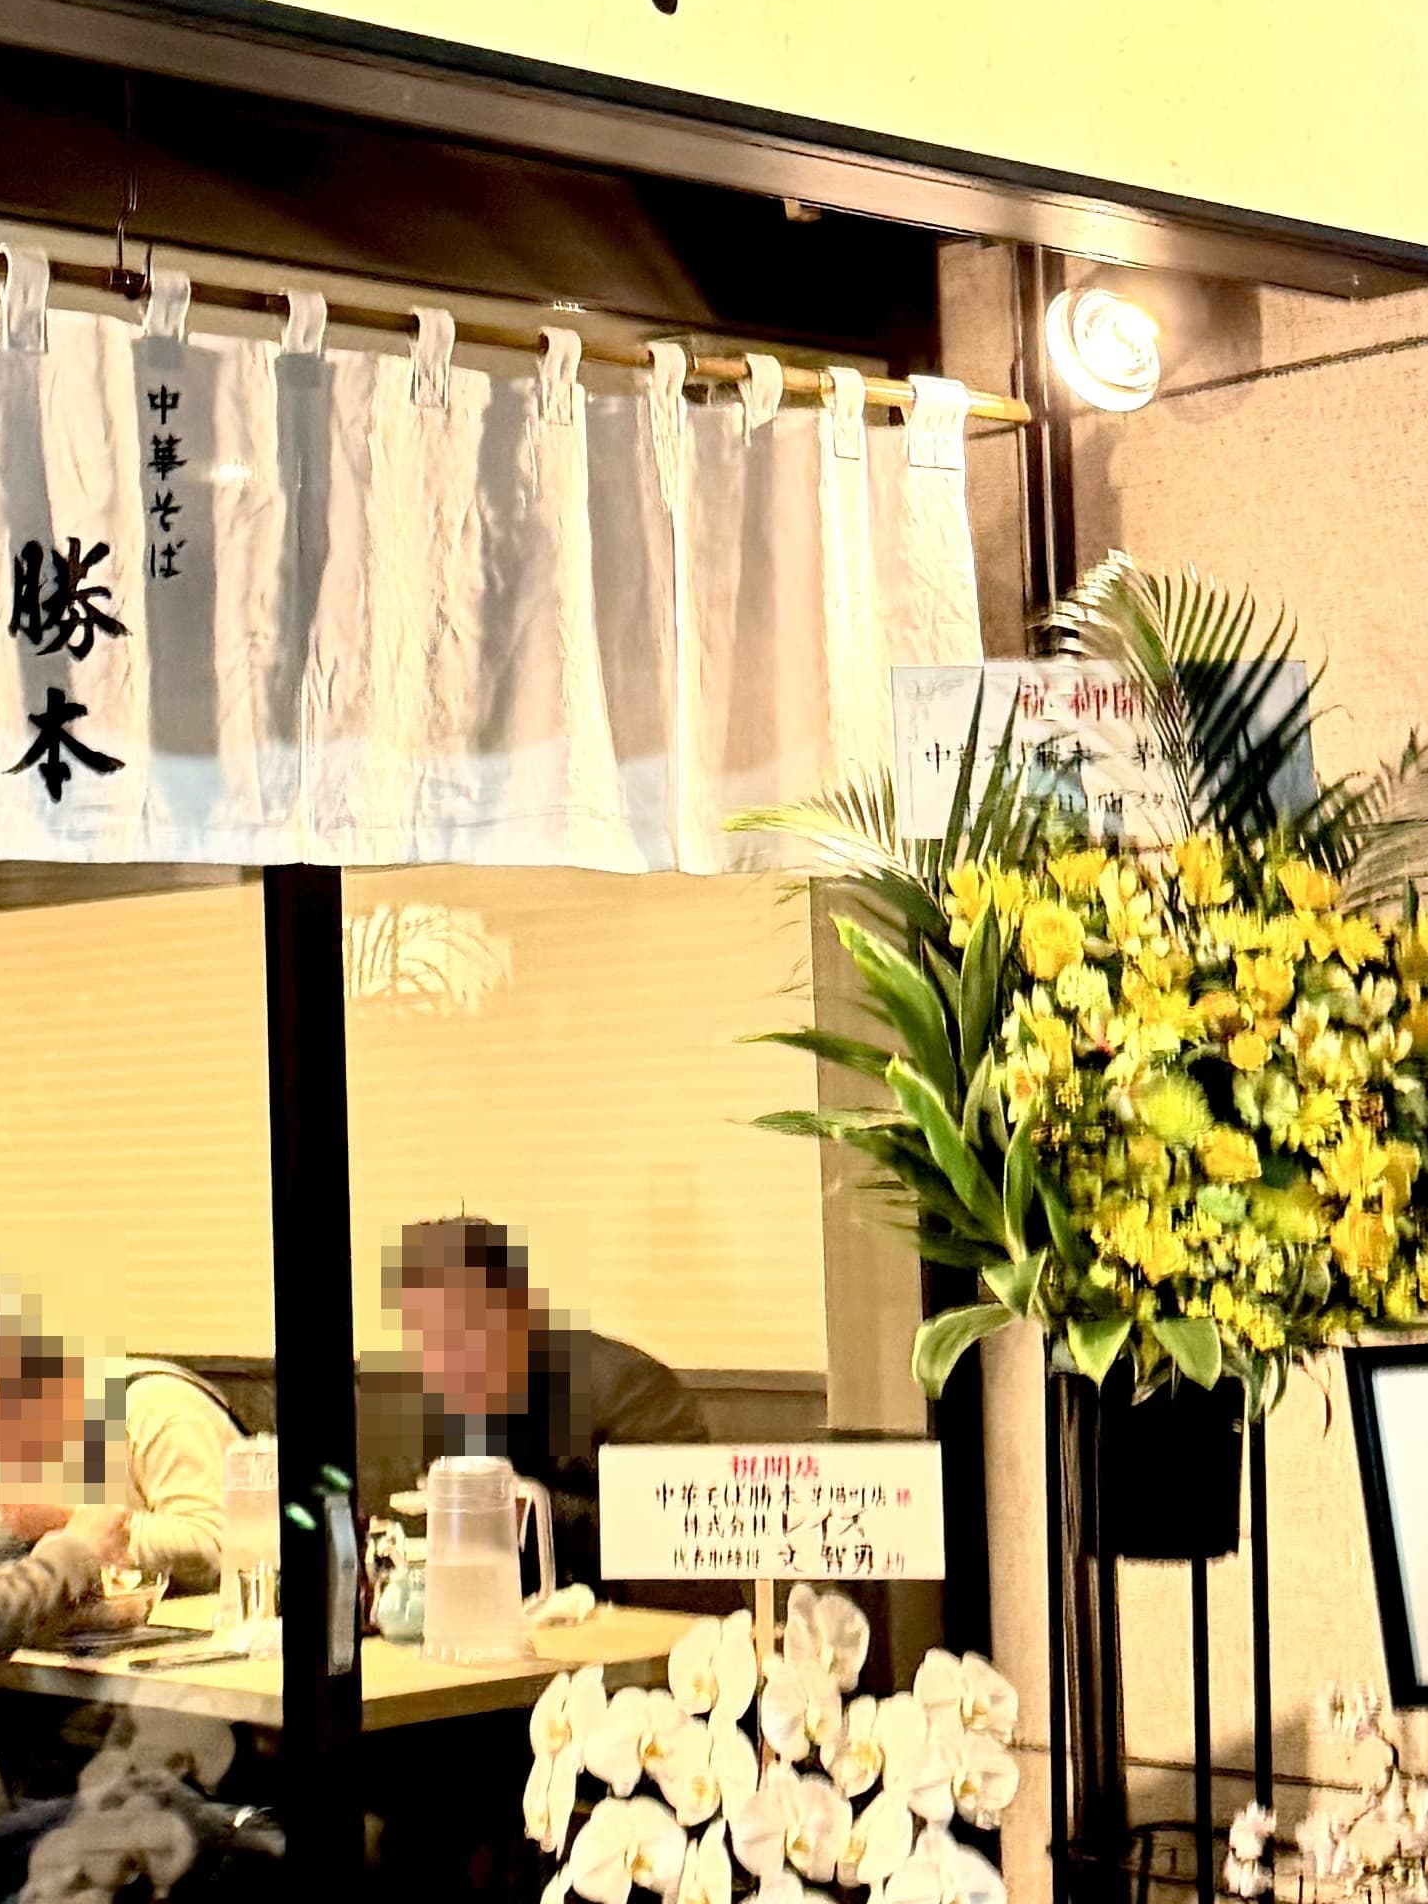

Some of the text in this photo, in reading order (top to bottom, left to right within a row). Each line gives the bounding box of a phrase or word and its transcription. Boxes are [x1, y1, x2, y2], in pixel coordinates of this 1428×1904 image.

[147, 384, 188, 579] 中華そば
[3, 536, 134, 802] 勝本
